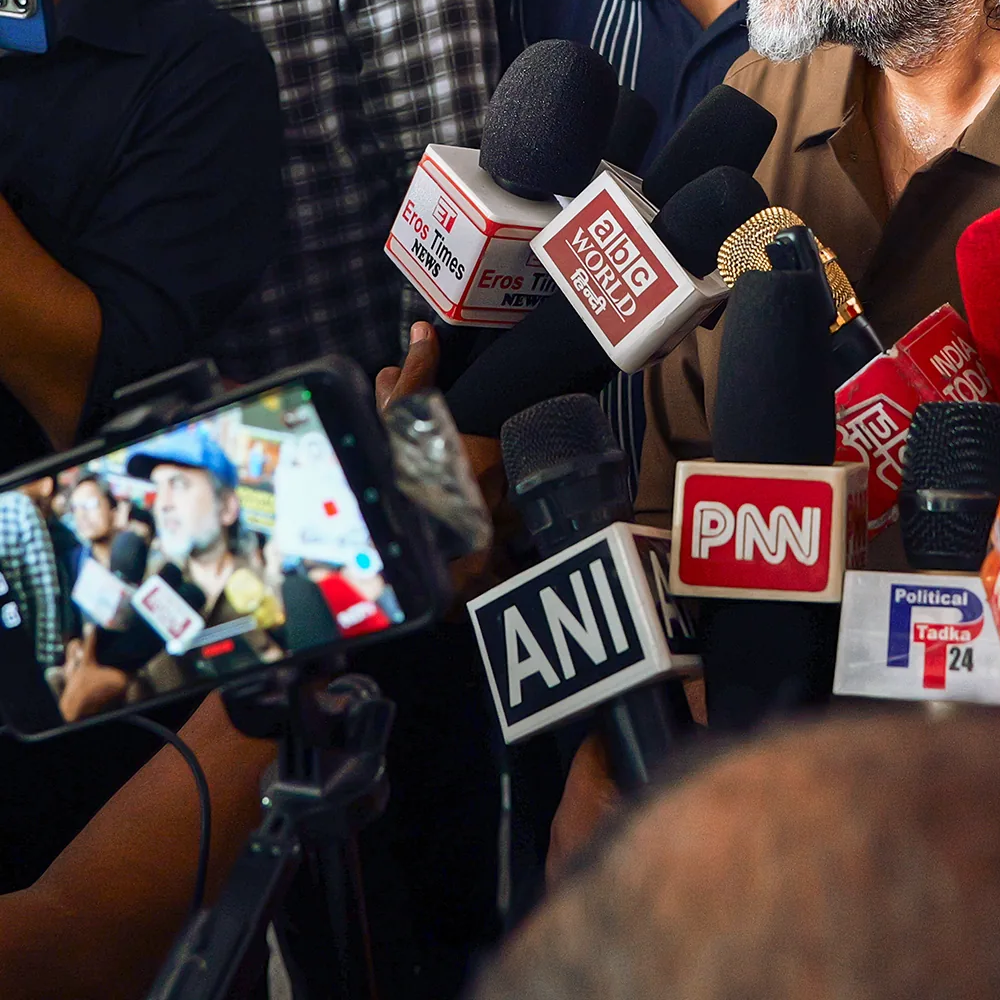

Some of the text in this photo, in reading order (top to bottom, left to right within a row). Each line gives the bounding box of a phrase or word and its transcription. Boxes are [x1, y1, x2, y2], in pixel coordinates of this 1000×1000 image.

[402, 199, 466, 281] Eros Times
[411, 238, 441, 278] NEWS
[592, 217, 652, 290] abc
[477, 269, 524, 290] Eros
[570, 267, 607, 316] हिन्दी
[572, 227, 636, 317] WORLD
[930, 336, 978, 378] INDIA
[692, 500, 821, 566] PNN
[895, 588, 968, 607] Political
[503, 558, 630, 708] ANI
[916, 625, 972, 642] Tadka
[948, 646, 974, 672] 24
